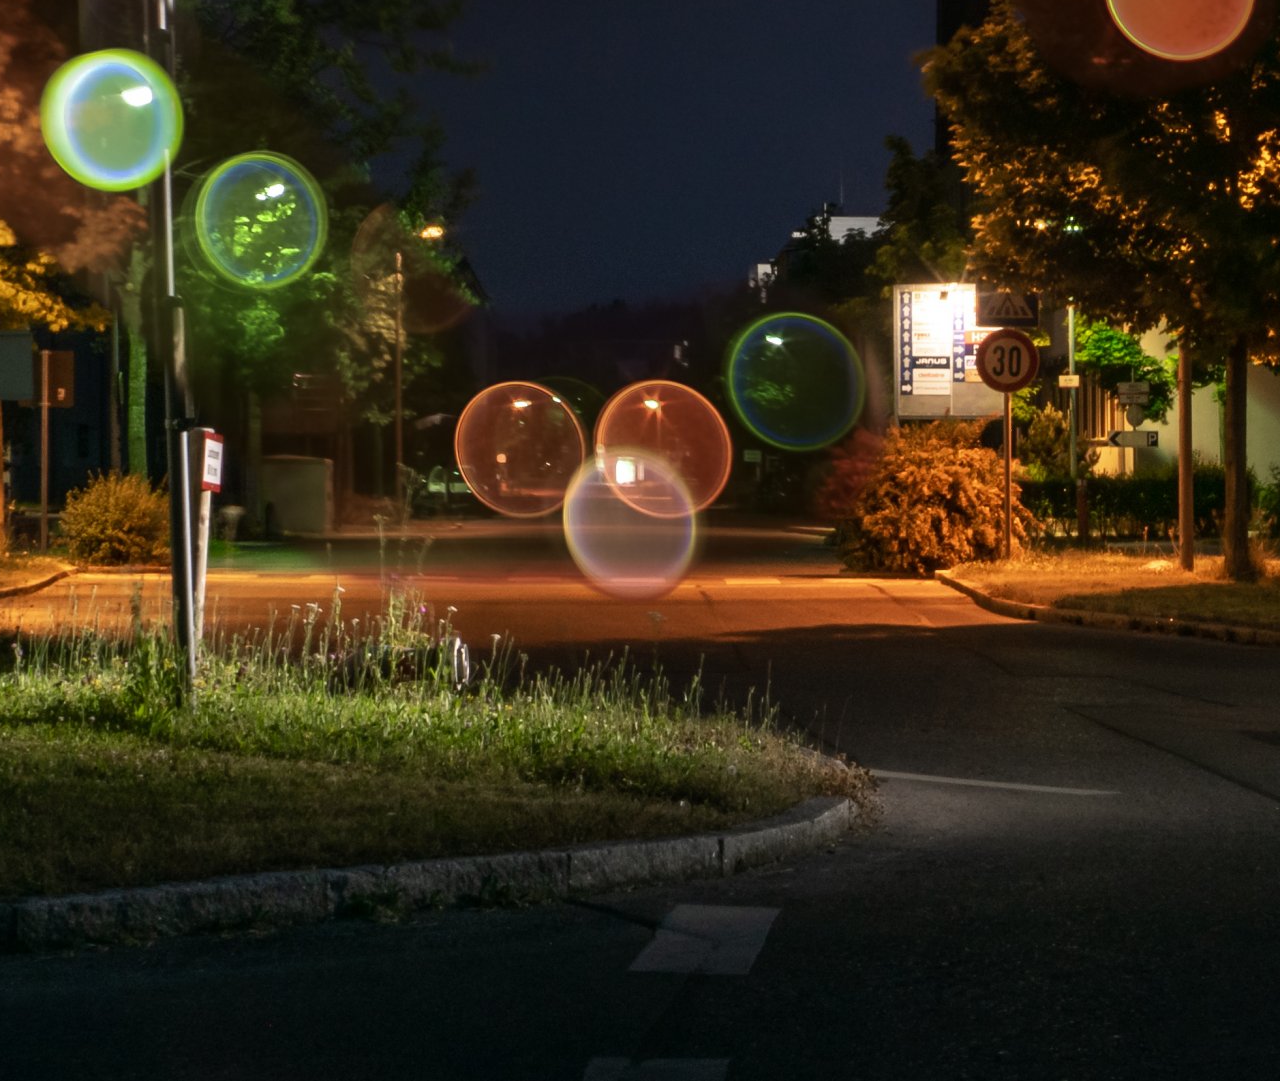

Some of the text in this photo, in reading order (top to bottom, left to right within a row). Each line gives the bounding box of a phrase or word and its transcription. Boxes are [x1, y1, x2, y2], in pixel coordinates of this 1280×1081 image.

[915, 358, 947, 366] JANUS
[992, 345, 1021, 377] 30
[1148, 432, 1158, 446] P
